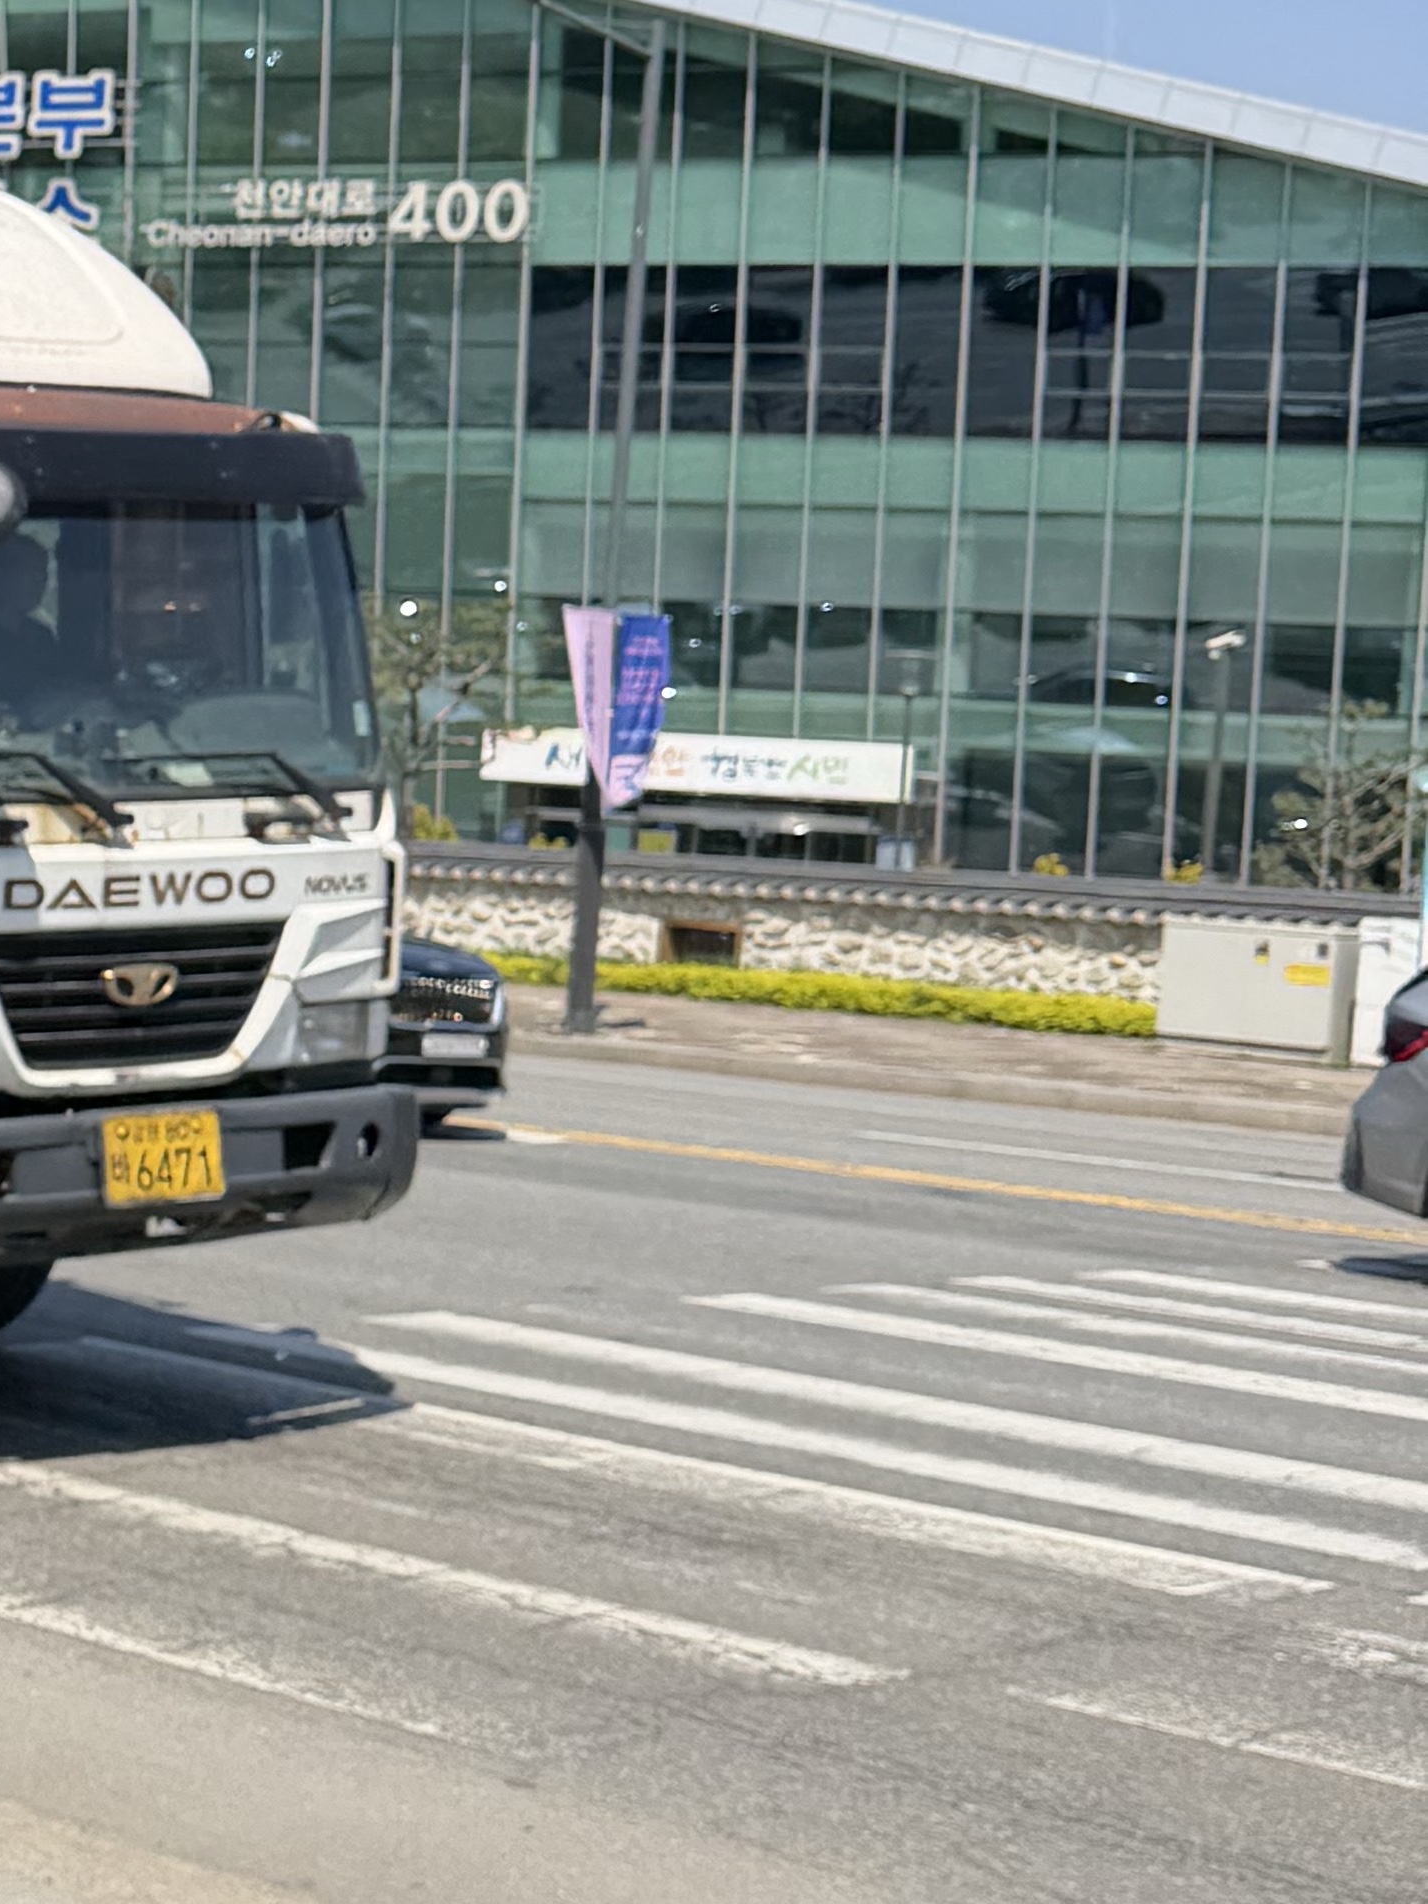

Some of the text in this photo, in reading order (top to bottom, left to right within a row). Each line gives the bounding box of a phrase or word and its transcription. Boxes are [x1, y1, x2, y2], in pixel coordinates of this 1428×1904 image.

[387, 179, 530, 243] 400
[2, 867, 276, 911] DAEWOO
[136, 1144, 212, 1191] 6471
